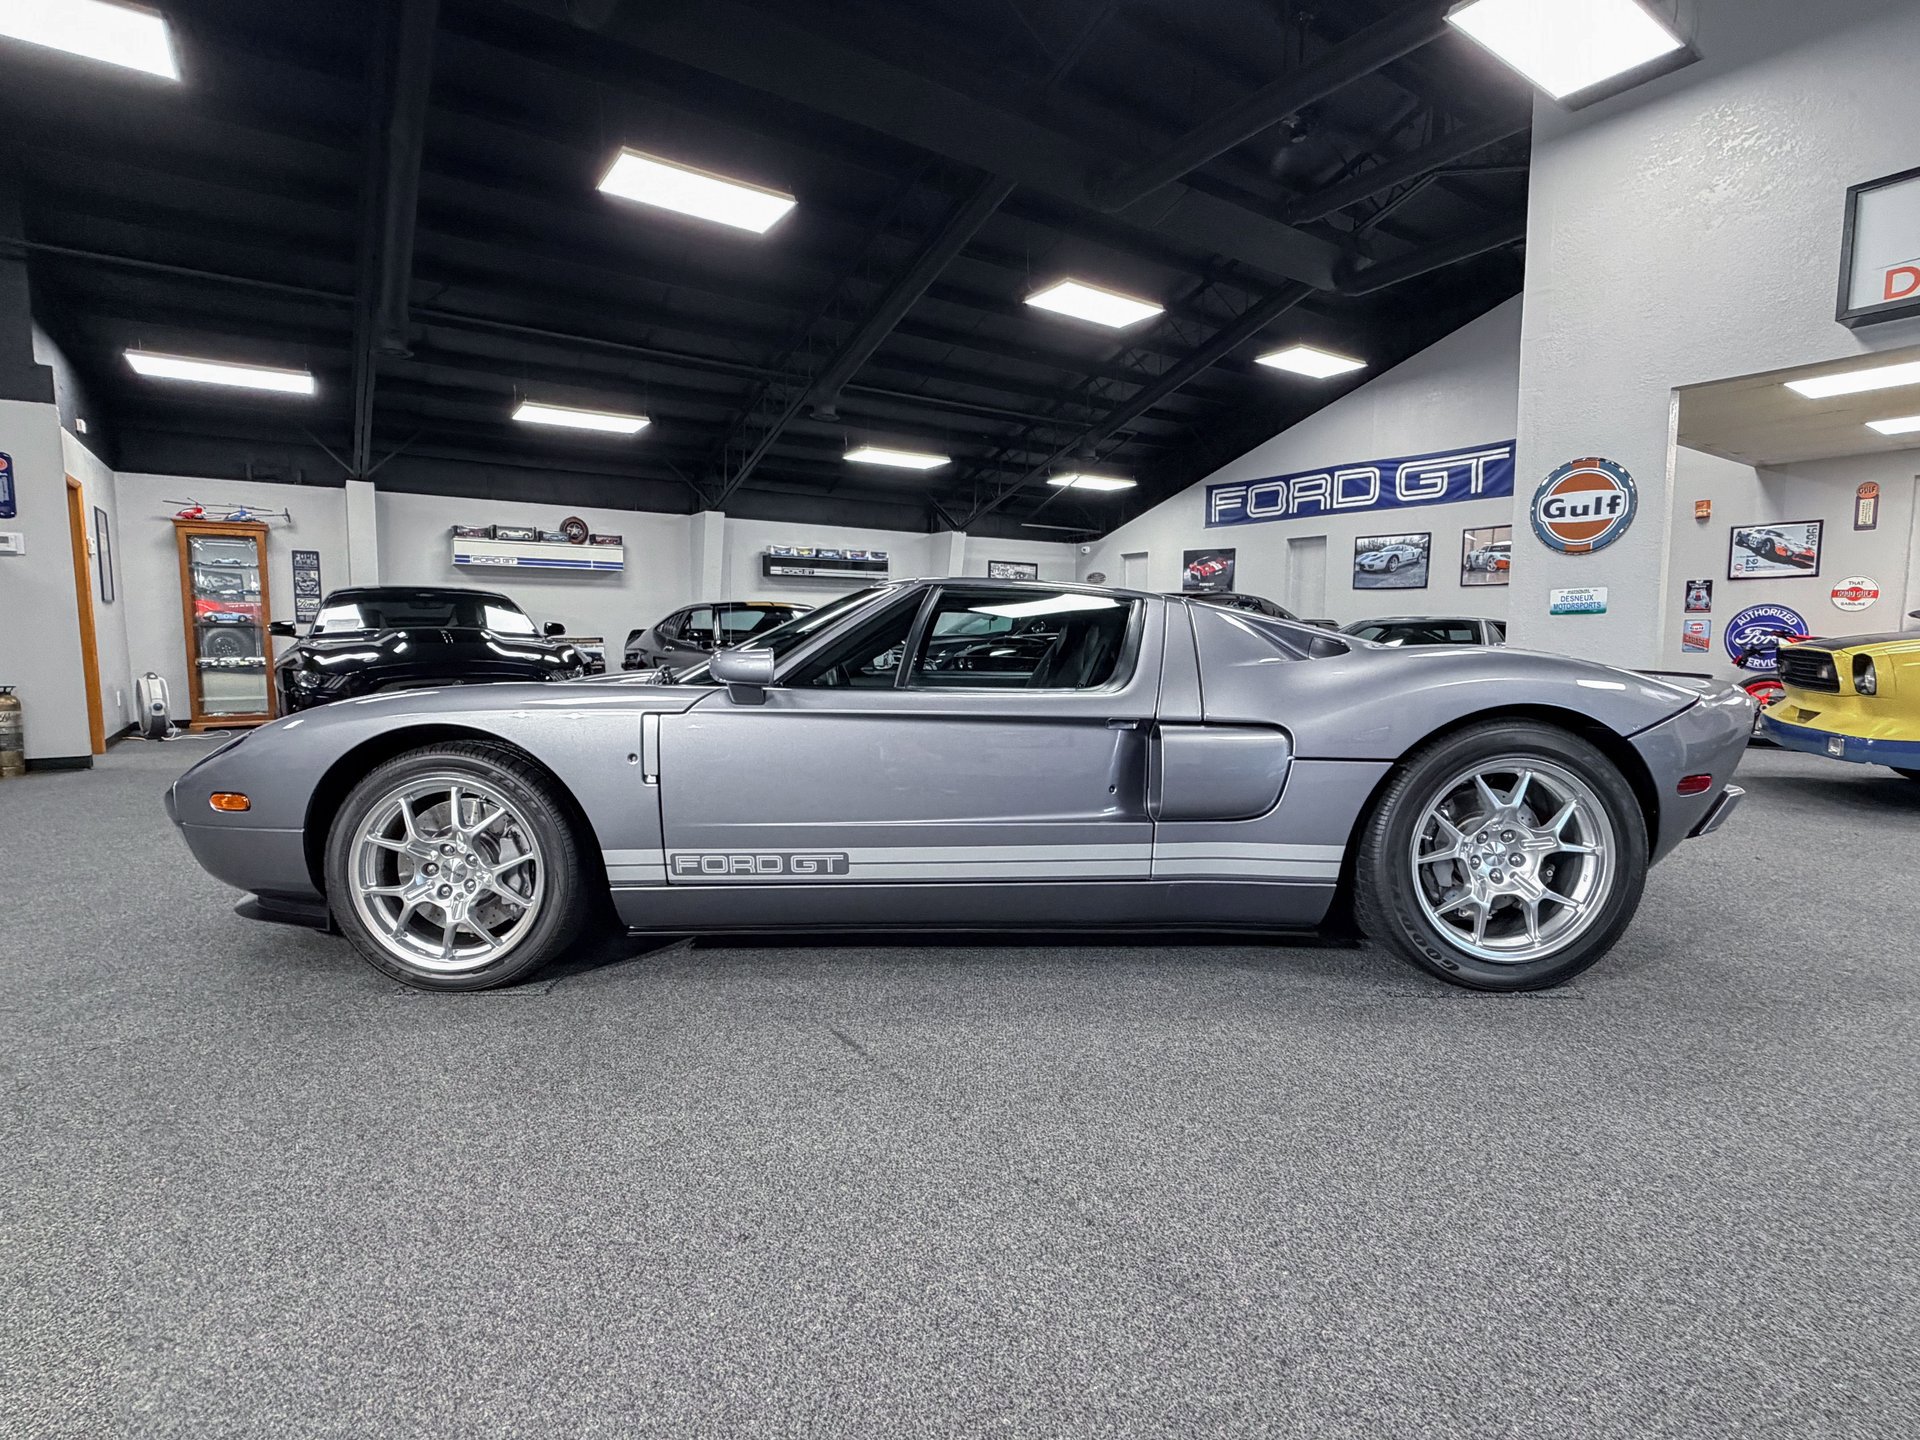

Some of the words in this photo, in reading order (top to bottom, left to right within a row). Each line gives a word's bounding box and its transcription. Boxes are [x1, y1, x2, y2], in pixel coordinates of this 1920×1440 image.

[1211, 466, 1380, 523] FORD
[1396, 447, 1510, 501] GT
[1542, 495, 1622, 519] Gulf
[1553, 601, 1602, 610] MOTORSPORTS
[1560, 594, 1594, 602] DESNEUX
[1736, 608, 1798, 626] AUTHORIZED
[1735, 627, 1778, 645] For
[1746, 657, 1777, 667] ERVIC
[675, 855, 783, 874] FORD
[791, 855, 844, 873] GT
